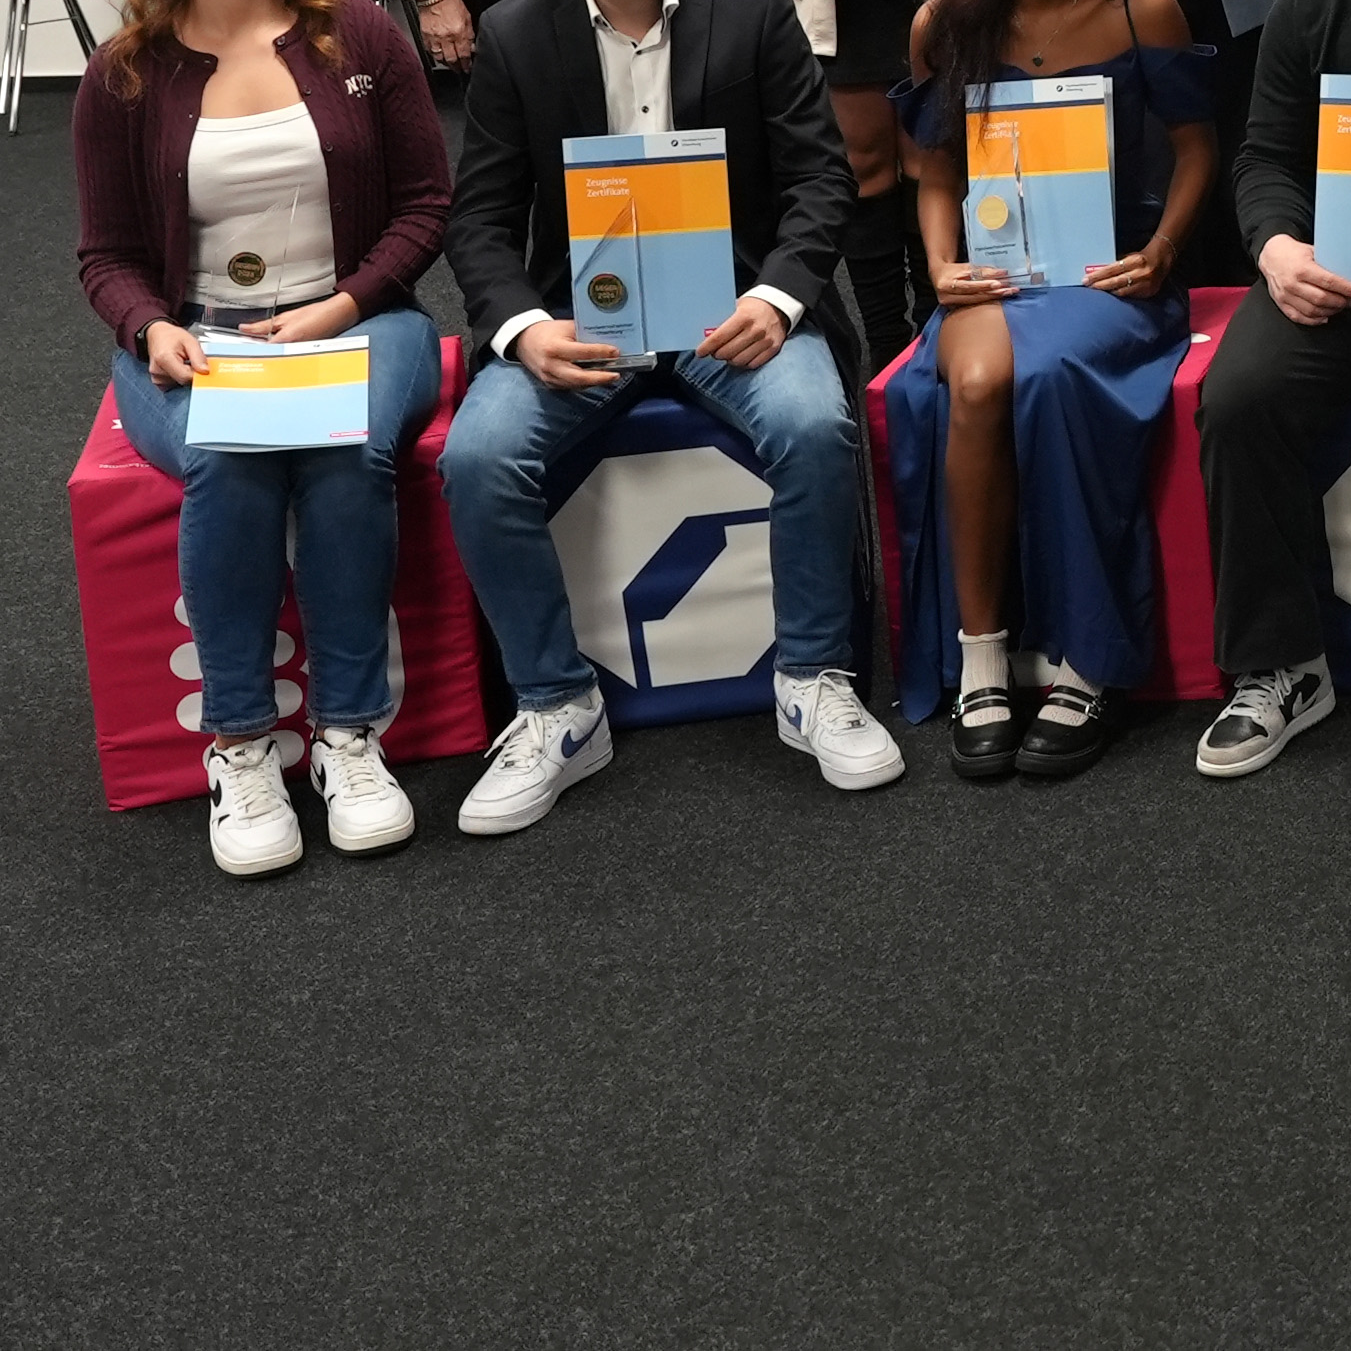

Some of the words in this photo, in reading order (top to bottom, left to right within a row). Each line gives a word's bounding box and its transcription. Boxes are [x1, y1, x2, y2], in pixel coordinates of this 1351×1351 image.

[344, 74, 373, 95] NYC
[586, 176, 628, 188] Zeugnisse
[586, 188, 630, 198] Zertifikate
